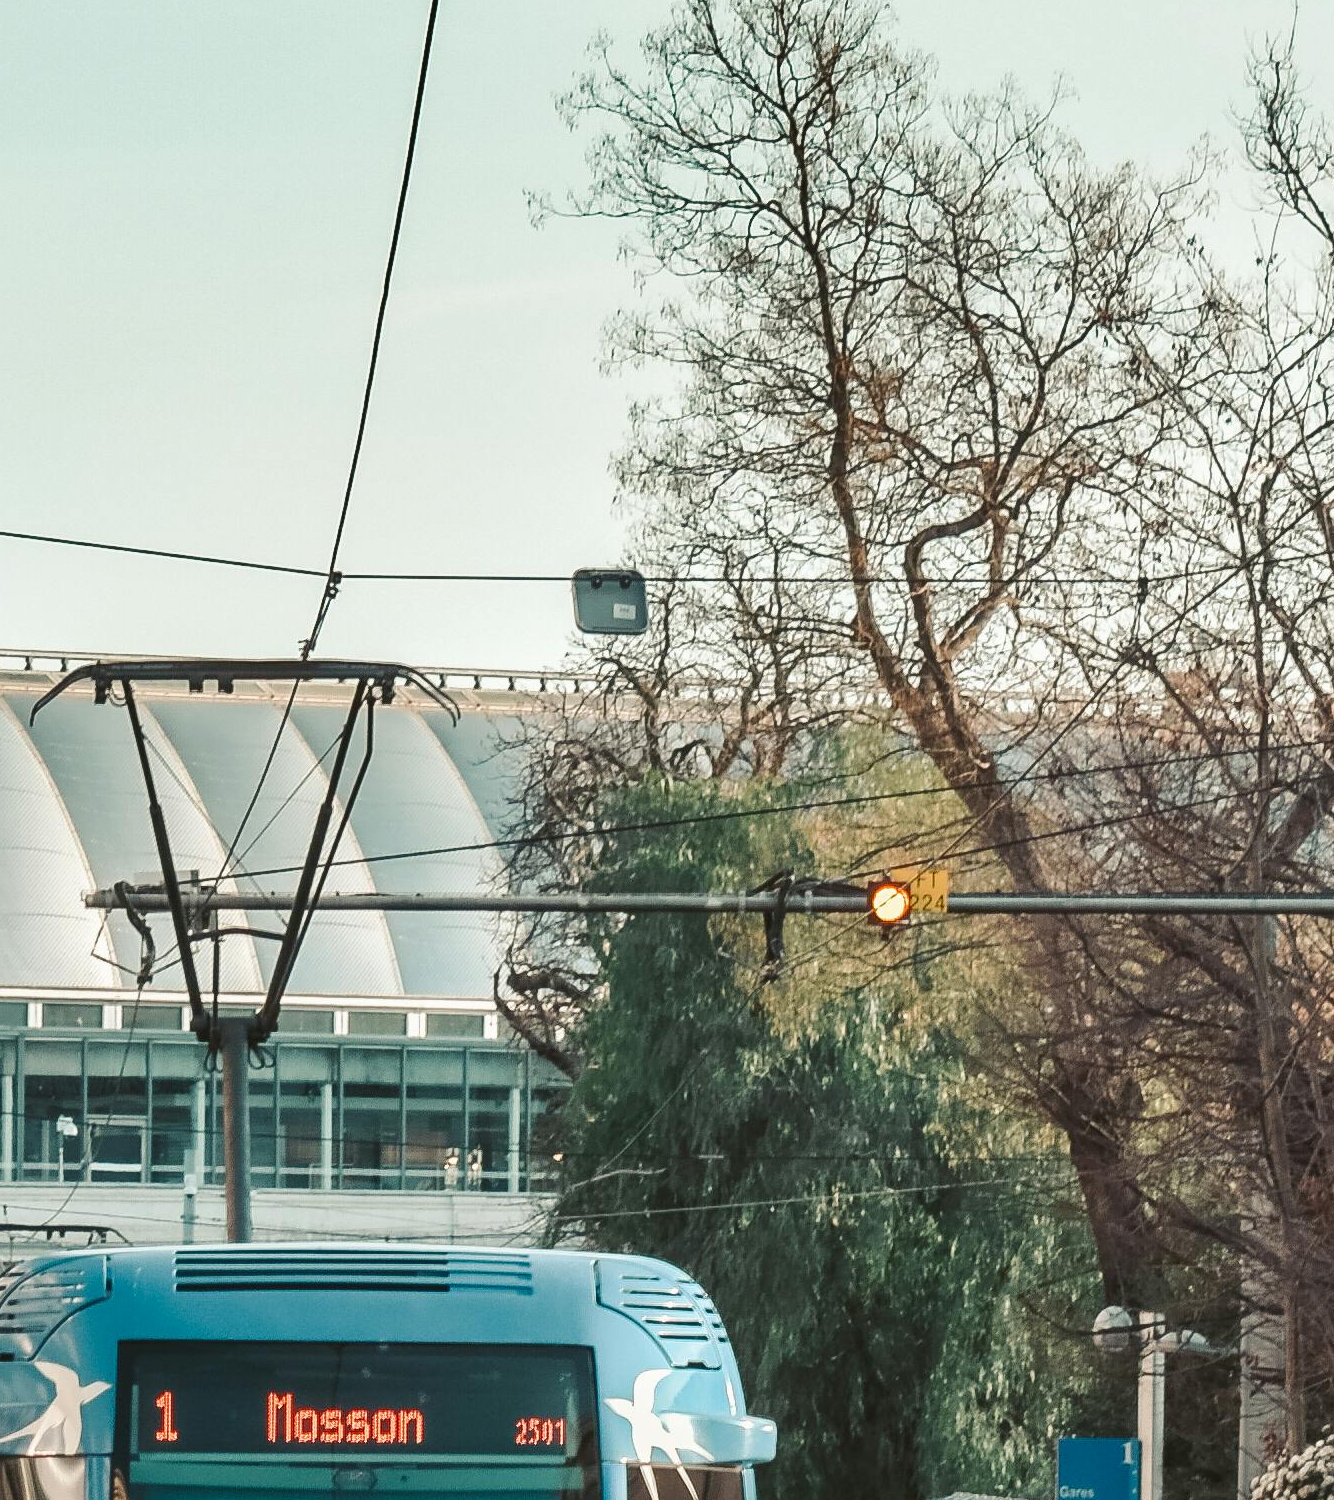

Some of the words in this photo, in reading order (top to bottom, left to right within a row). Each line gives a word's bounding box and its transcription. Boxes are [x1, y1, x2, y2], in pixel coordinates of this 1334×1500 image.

[910, 894, 945, 913] 224
[154, 1391, 179, 1442] 1
[267, 1391, 424, 1444] Mosson
[515, 1417, 566, 1446] 2501
[1123, 1442, 1133, 1464] 1
[1059, 1485, 1095, 1499] Gares
